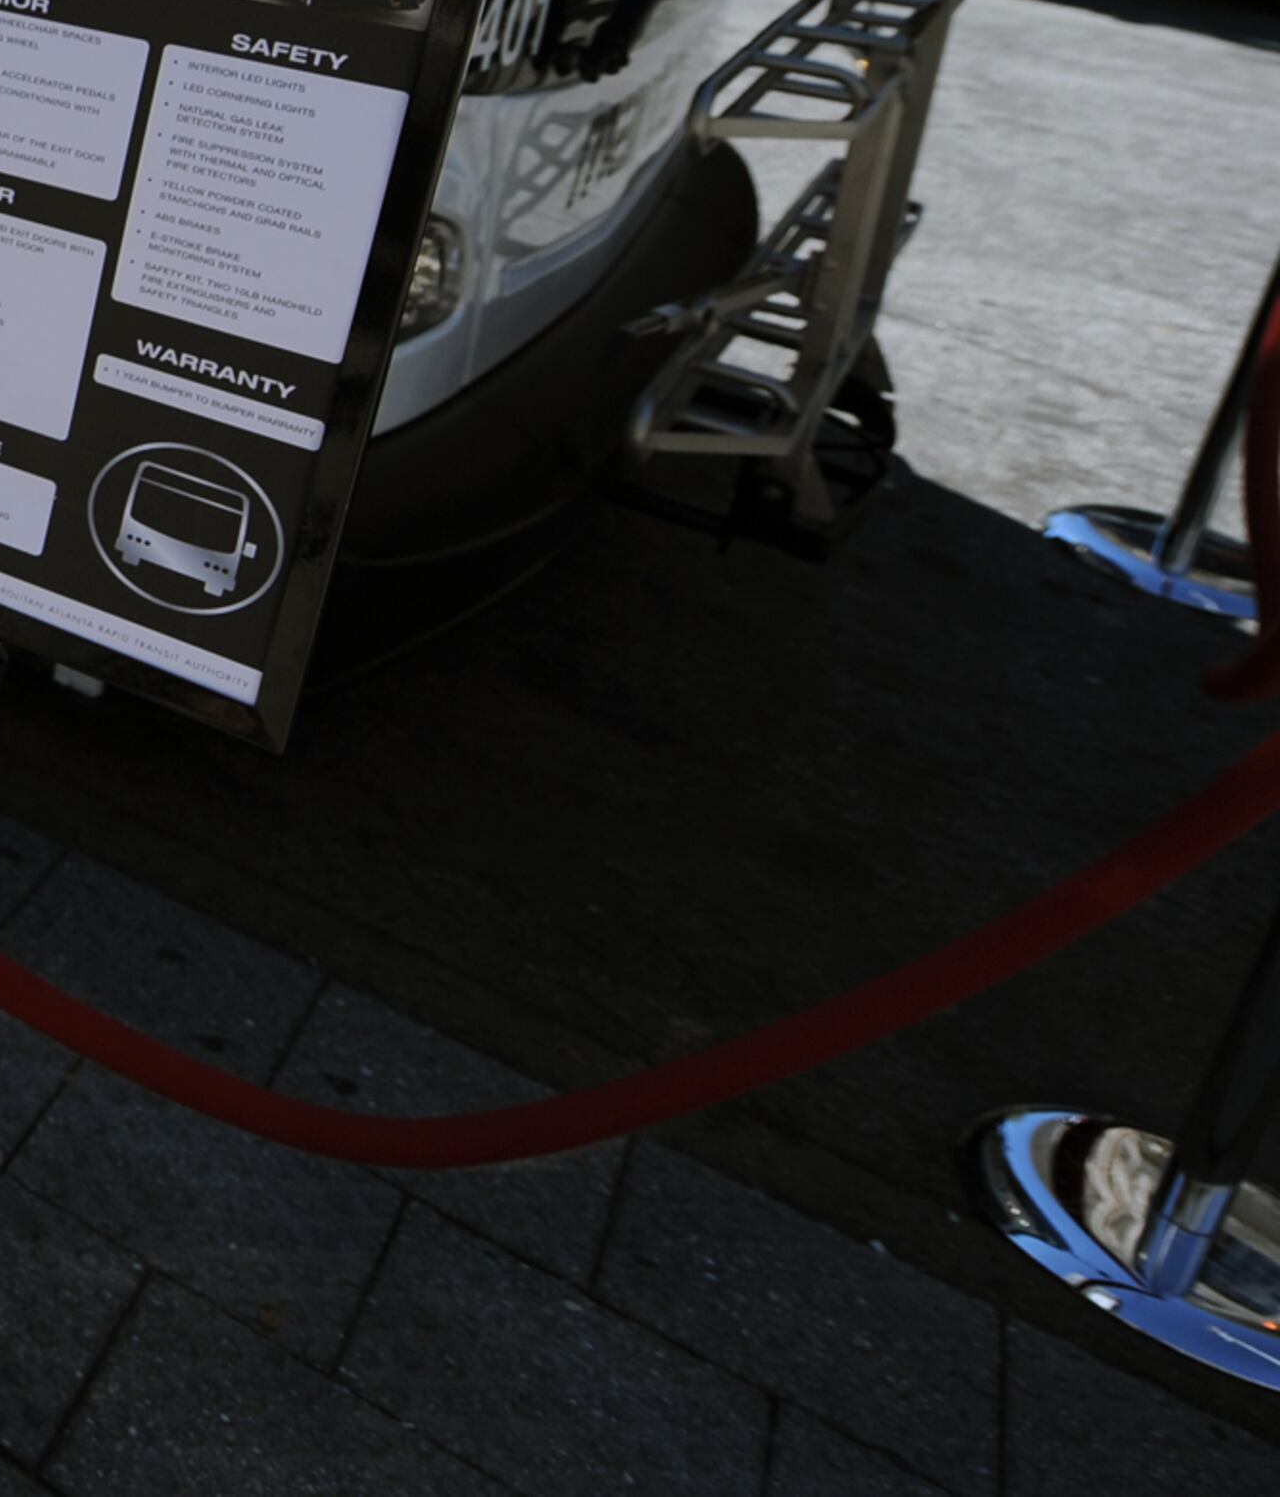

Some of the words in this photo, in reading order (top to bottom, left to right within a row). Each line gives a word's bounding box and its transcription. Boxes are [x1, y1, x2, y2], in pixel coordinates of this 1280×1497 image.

[5, 35, 41, 50] WHEEL
[60, 30, 101, 45] SPACES
[231, 34, 349, 71] SAFETY
[0, 68, 74, 91] ACCELERATOR
[74, 85, 116, 101] PEDALS
[187, 61, 239, 79] INTERIOR
[239, 72, 263, 84] LED
[264, 77, 306, 93] LIGHTS
[73, 102, 100, 115] WITH
[182, 82, 204, 93] LED
[205, 87, 273, 108] CORNERING
[273, 101, 316, 117] LIGHTS
[175, 113, 237, 134] DETECTION
[238, 127, 284, 144] SYSTEM
[178, 103, 227, 120] NATURAL
[227, 114, 253, 126] GAS
[254, 120, 284, 133] LEAK
[11, 134, 26, 144] OF
[27, 138, 48, 149] THE
[49, 143, 72, 155] EXIT
[73, 149, 105, 163] DOOR
[171, 134, 195, 146] FIRE
[196, 140, 275, 164] SUPPRESSION
[276, 158, 323, 175] SYSTEM
[165, 159, 189, 171] FIRE
[190, 165, 257, 187] DETECTORS
[168, 146, 197, 159] WITH
[198, 153, 249, 172] THERMAL
[250, 165, 276, 178] AND
[277, 172, 327, 190] OPTICAL
[158, 192, 227, 215] STANCHIONS
[228, 209, 253, 221] AND
[254, 215, 286, 230] GRAB
[287, 223, 322, 238] RAILS
[161, 179, 205, 196] YELLOW
[206, 190, 255, 209] POWDER
[256, 202, 302, 220] COATED
[154, 211, 176, 223] ABS
[177, 217, 221, 235] BRAKES
[147, 242, 216, 267] MONITORING
[216, 261, 262, 279] SYSTEM
[203, 245, 241, 261] BRAKE
[138, 285, 178, 302] SAFETY
[179, 297, 239, 320] TRIANGLES
[140, 273, 164, 286] FIRE
[165, 280, 251, 310] EXTINGUISHERS
[252, 304, 276, 317] AND
[143, 262, 182, 278] SAFETY
[205, 278, 232, 292] TWO
[261, 293, 323, 316] HANDHELD
[136, 338, 297, 401] WARRANTY
[115, 368, 121, 376] 1
[121, 371, 148, 385] YEAR
[149, 379, 193, 399] BUMPER
[194, 393, 209, 404] TO
[210, 398, 255, 418] BUMPER
[256, 413, 315, 437] WARRANTY
